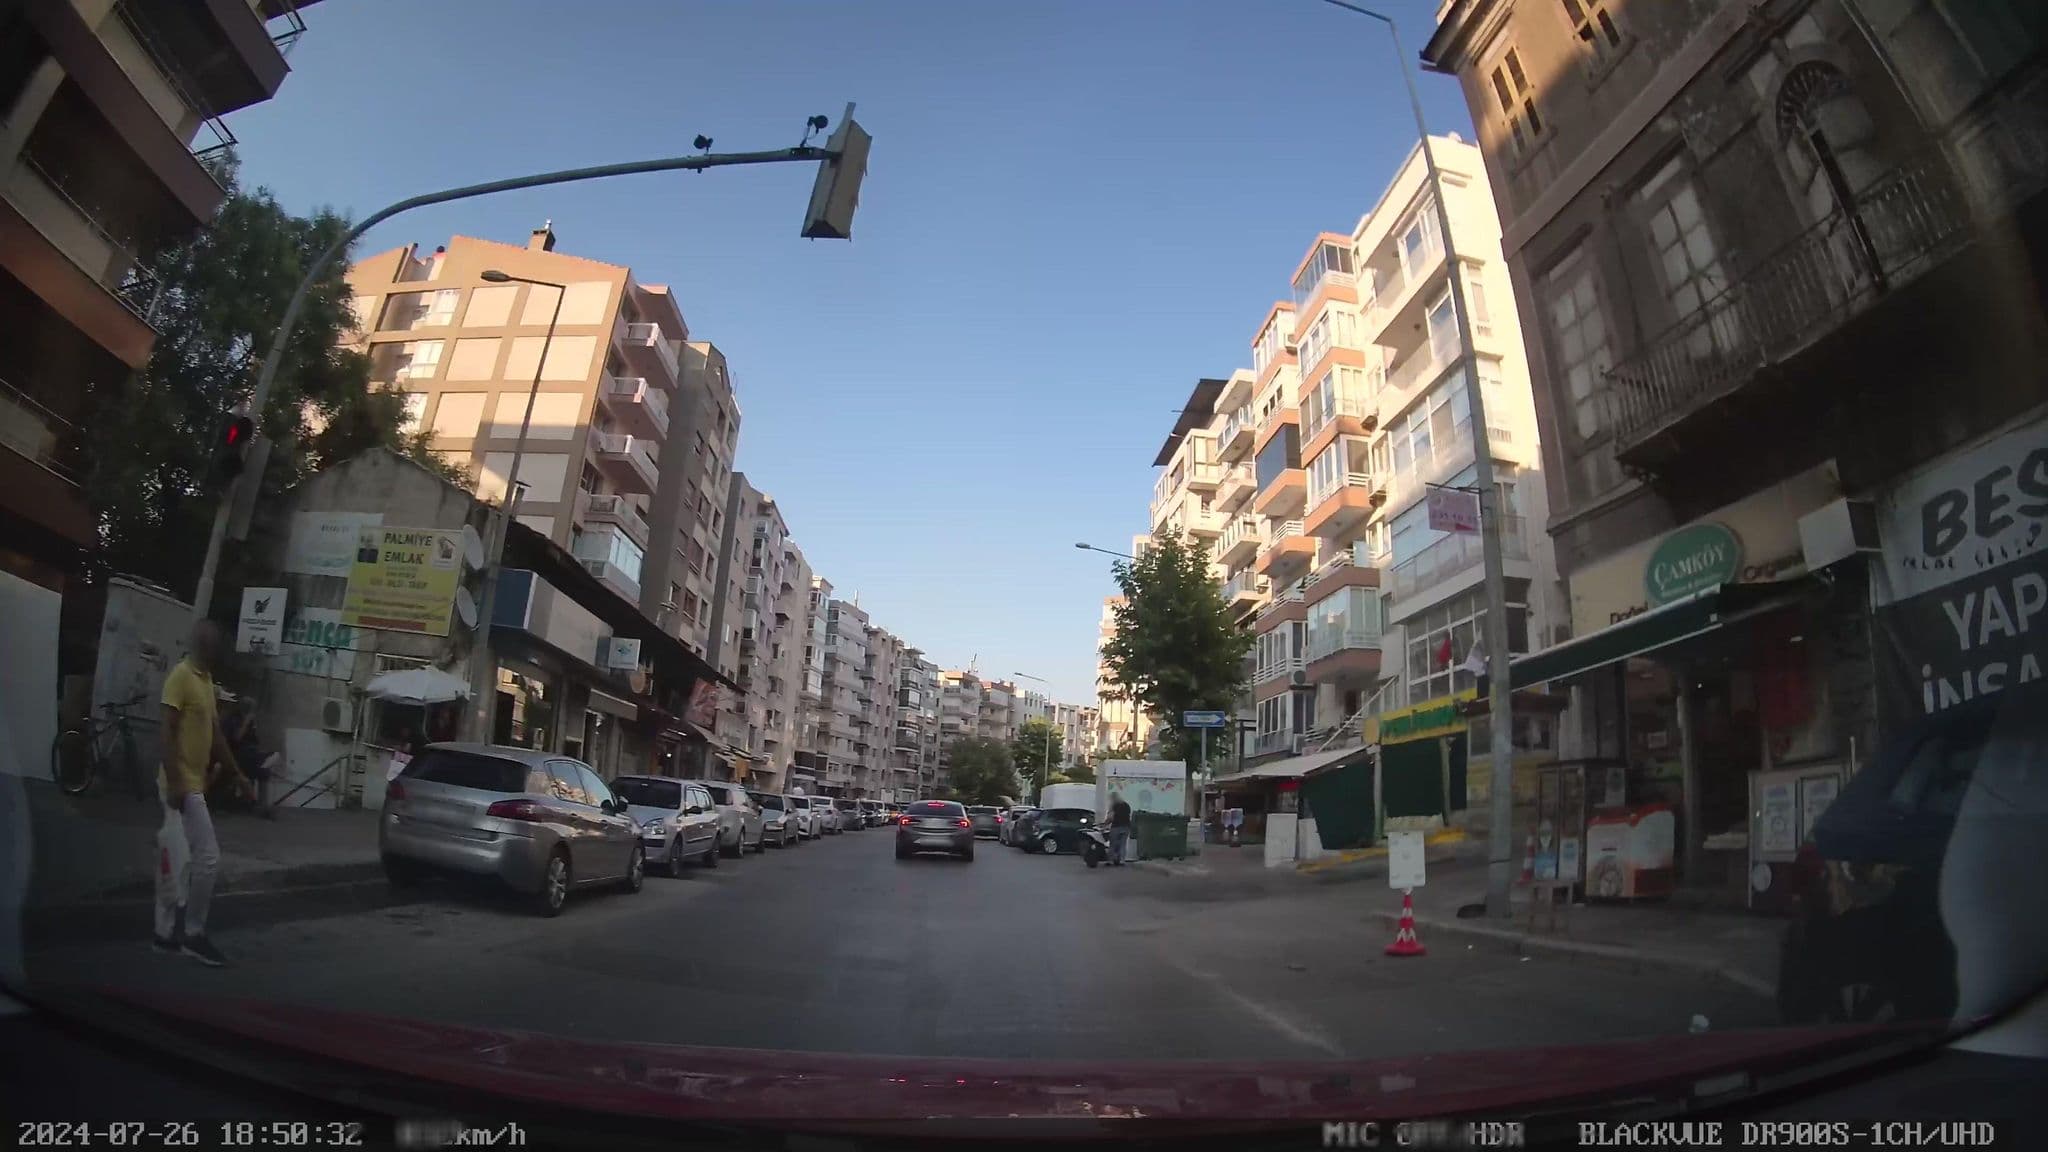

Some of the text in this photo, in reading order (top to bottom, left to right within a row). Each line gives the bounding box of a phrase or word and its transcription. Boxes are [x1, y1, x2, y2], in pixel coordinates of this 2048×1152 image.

[384, 532, 433, 546] PALMİYE
[384, 551, 425, 564] EMLAK
[1654, 543, 1725, 591] ÇAMKÖY
